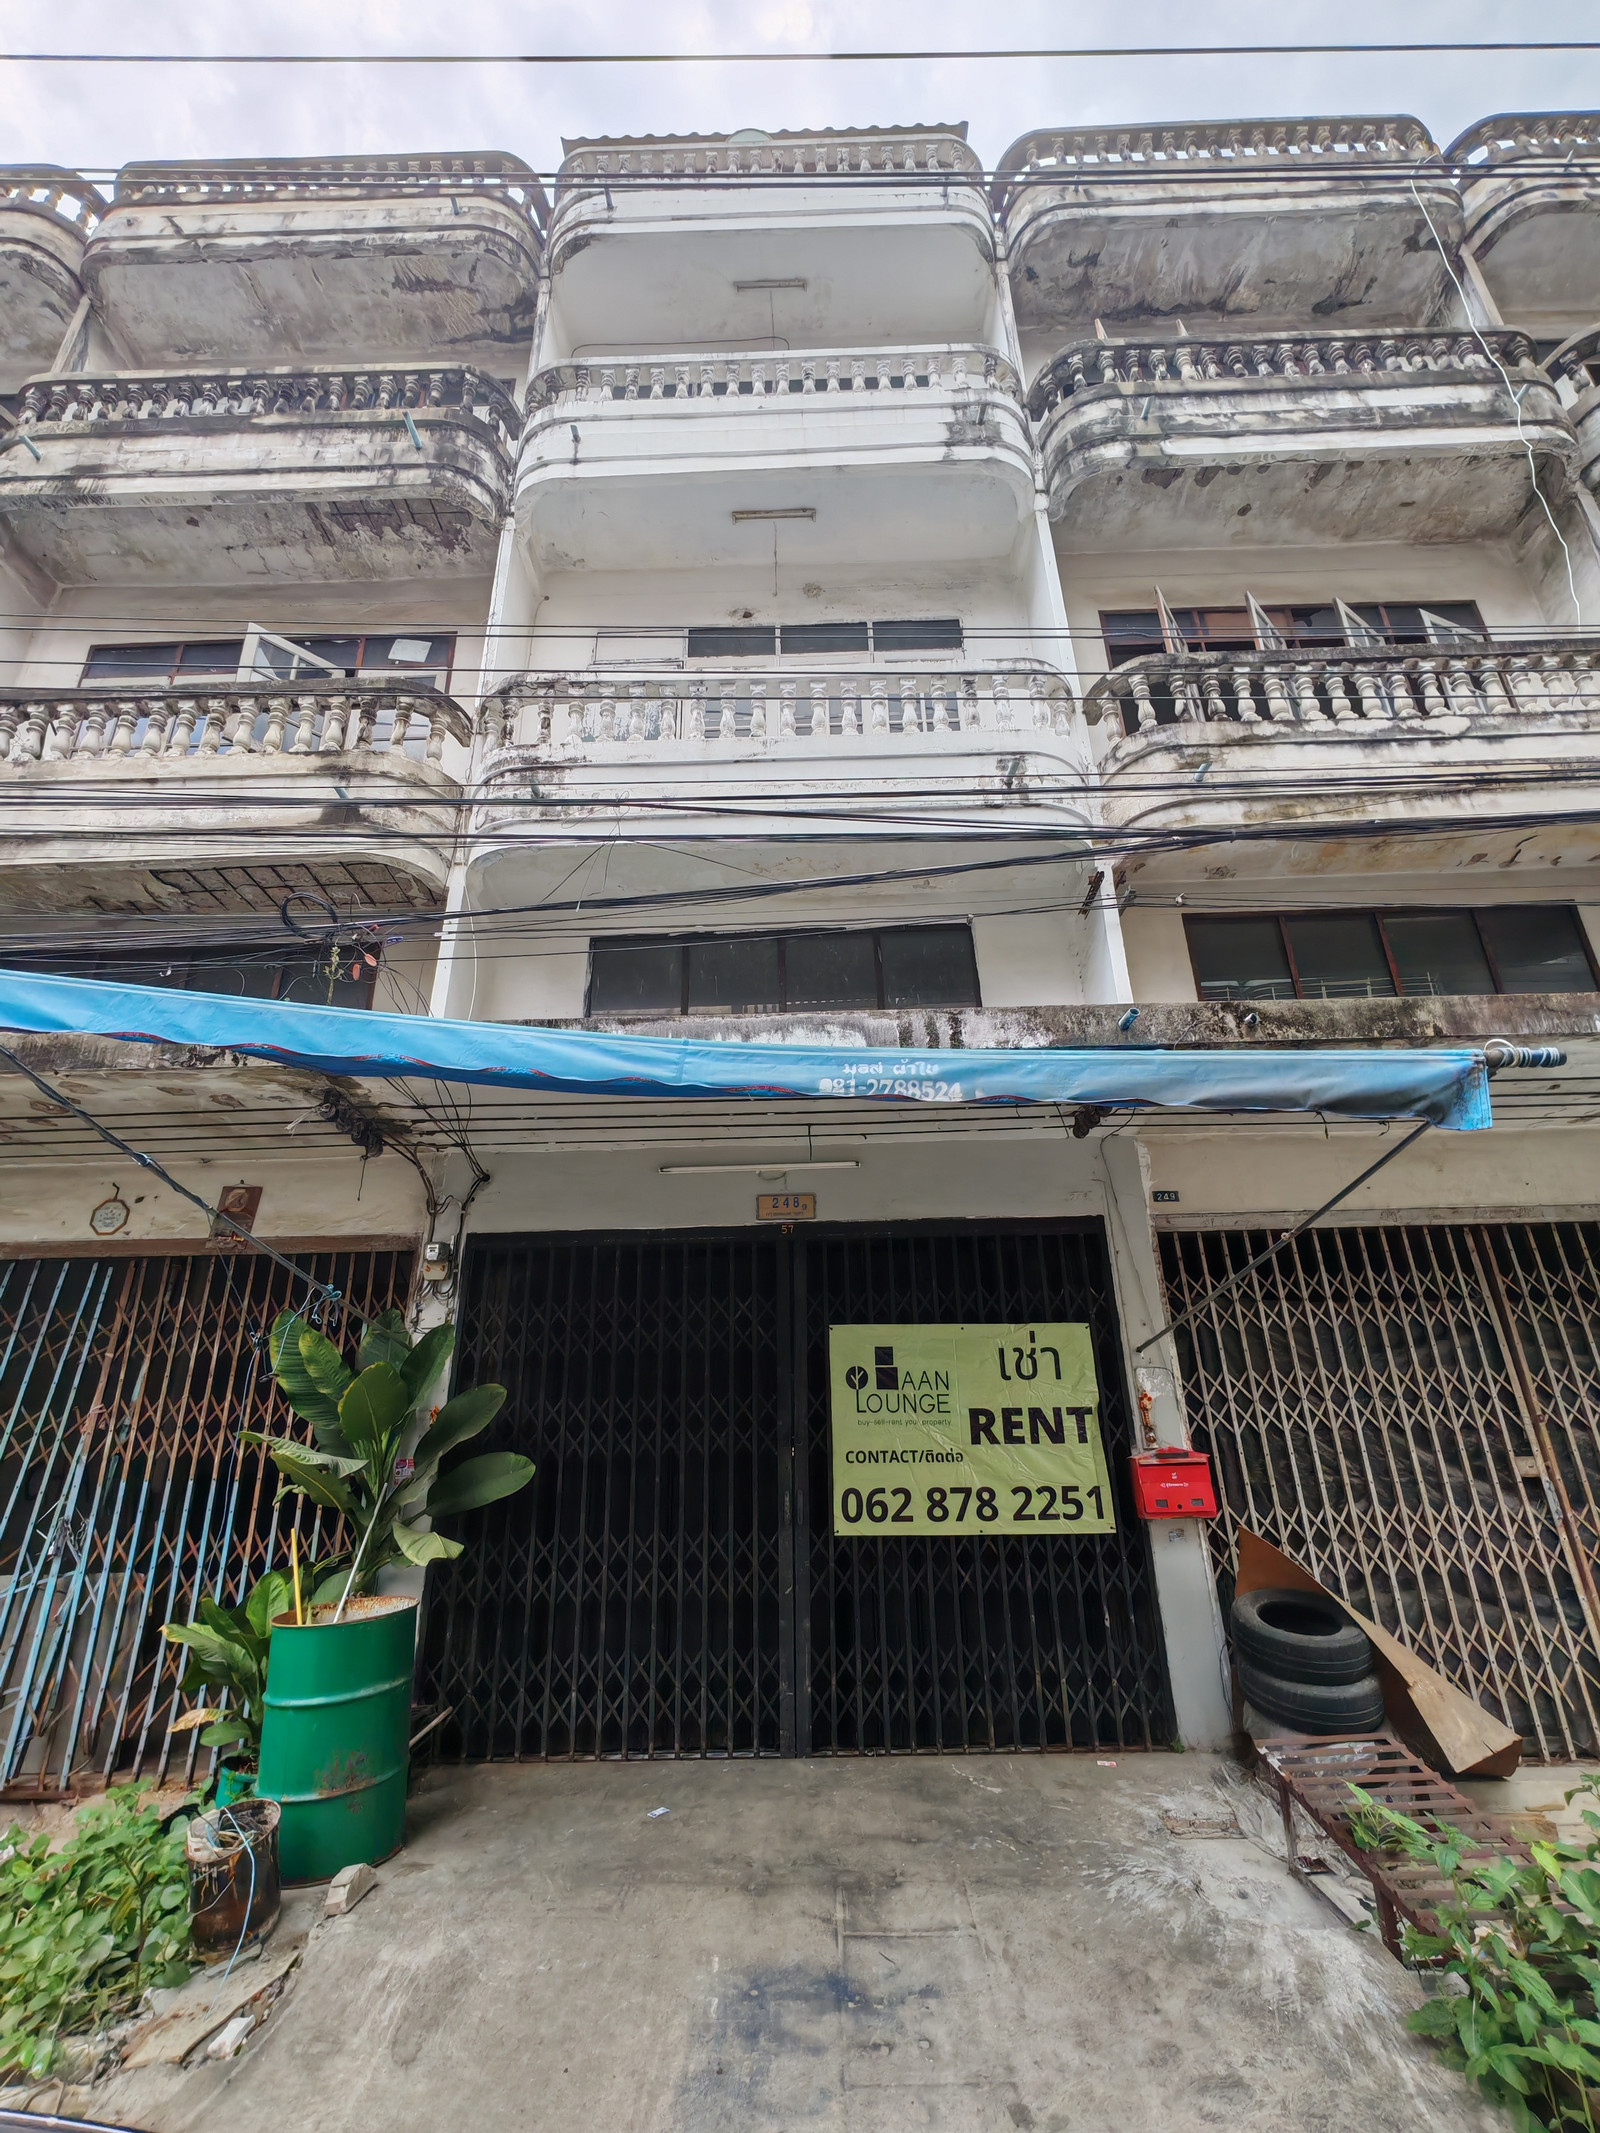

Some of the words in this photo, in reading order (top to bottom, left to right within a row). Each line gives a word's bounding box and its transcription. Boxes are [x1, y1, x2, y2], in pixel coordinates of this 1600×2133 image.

[1156, 1192, 1176, 1201] 249
[781, 1225, 794, 1234] 57
[998, 1331, 1062, 1381] เช่า
[856, 1391, 951, 1414] LOUNGE
[968, 1406, 1093, 1445] RENT
[841, 1487, 914, 1523] 062
[926, 1485, 1000, 1522] 878
[1011, 1485, 1105, 1521] 2251
